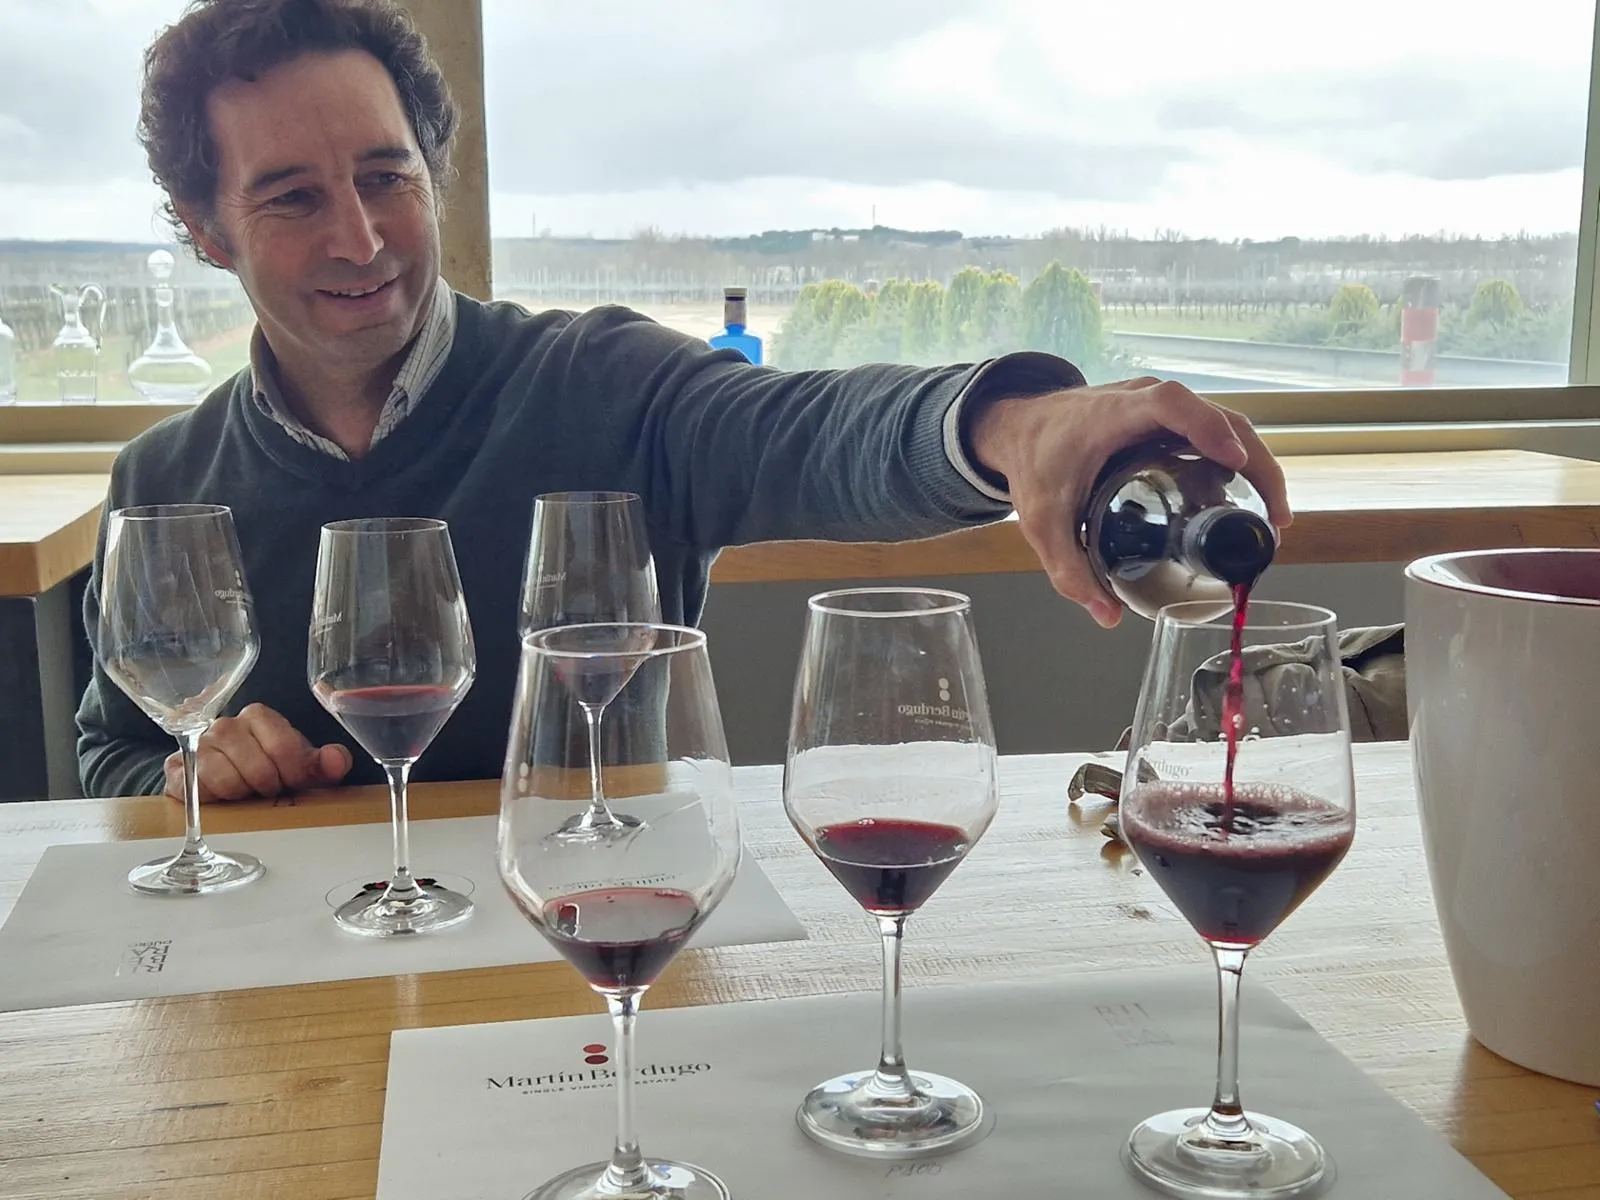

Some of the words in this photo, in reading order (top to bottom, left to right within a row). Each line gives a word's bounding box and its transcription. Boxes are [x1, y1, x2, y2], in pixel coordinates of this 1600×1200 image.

[1153, 758, 1190, 779] rdugo
[486, 1071, 584, 1089] Martín
[591, 1063, 711, 1080] Bdugo
[634, 1078, 678, 1086] ESTATE
